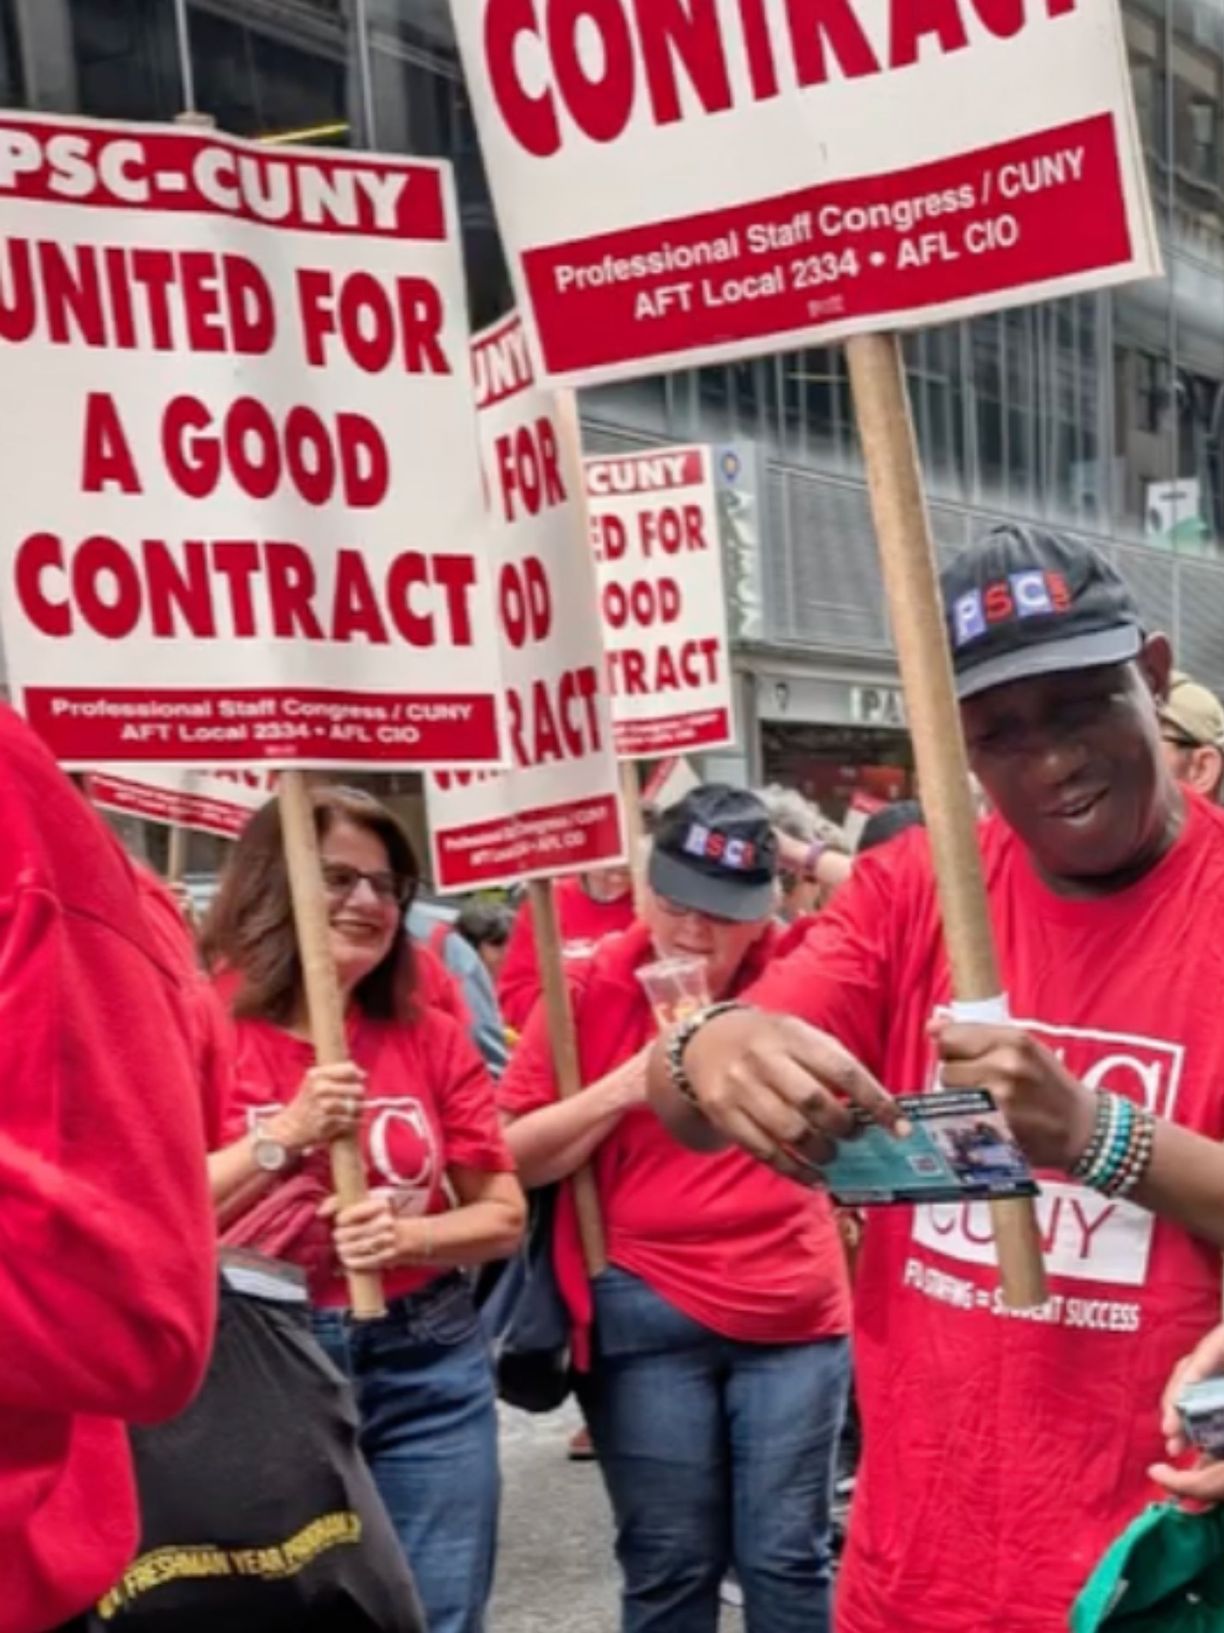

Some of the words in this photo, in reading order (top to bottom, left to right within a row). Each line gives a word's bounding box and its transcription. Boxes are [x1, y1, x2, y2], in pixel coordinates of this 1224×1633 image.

[0, 130, 408, 230] PSC-CUNY
[554, 236, 739, 294] Professional
[745, 211, 812, 257] Staff
[818, 183, 975, 239] Congress
[998, 147, 1086, 200] CUNY
[634, 283, 693, 320] AFT
[702, 264, 785, 308] Local
[792, 249, 860, 292] 2334
[895, 235, 959, 271] AFL
[963, 214, 1020, 255] CIO
[297, 269, 453, 375] FOR
[82, 392, 143, 494] A
[162, 395, 390, 508] GOOD
[495, 417, 568, 523] FOR
[637, 504, 706, 558] FOR
[15, 532, 477, 648] CONTRACT
[52, 698, 212, 719] Professional
[218, 698, 277, 718] Staff
[281, 699, 387, 722] Congress
[406, 703, 473, 721] CUNY
[121, 724, 172, 741] AFT
[179, 724, 247, 741] Local
[253, 723, 308, 740] 2334
[329, 723, 371, 742] AFL
[376, 725, 421, 744] CIO
[1064, 1297, 1141, 1332] SUCCESS
